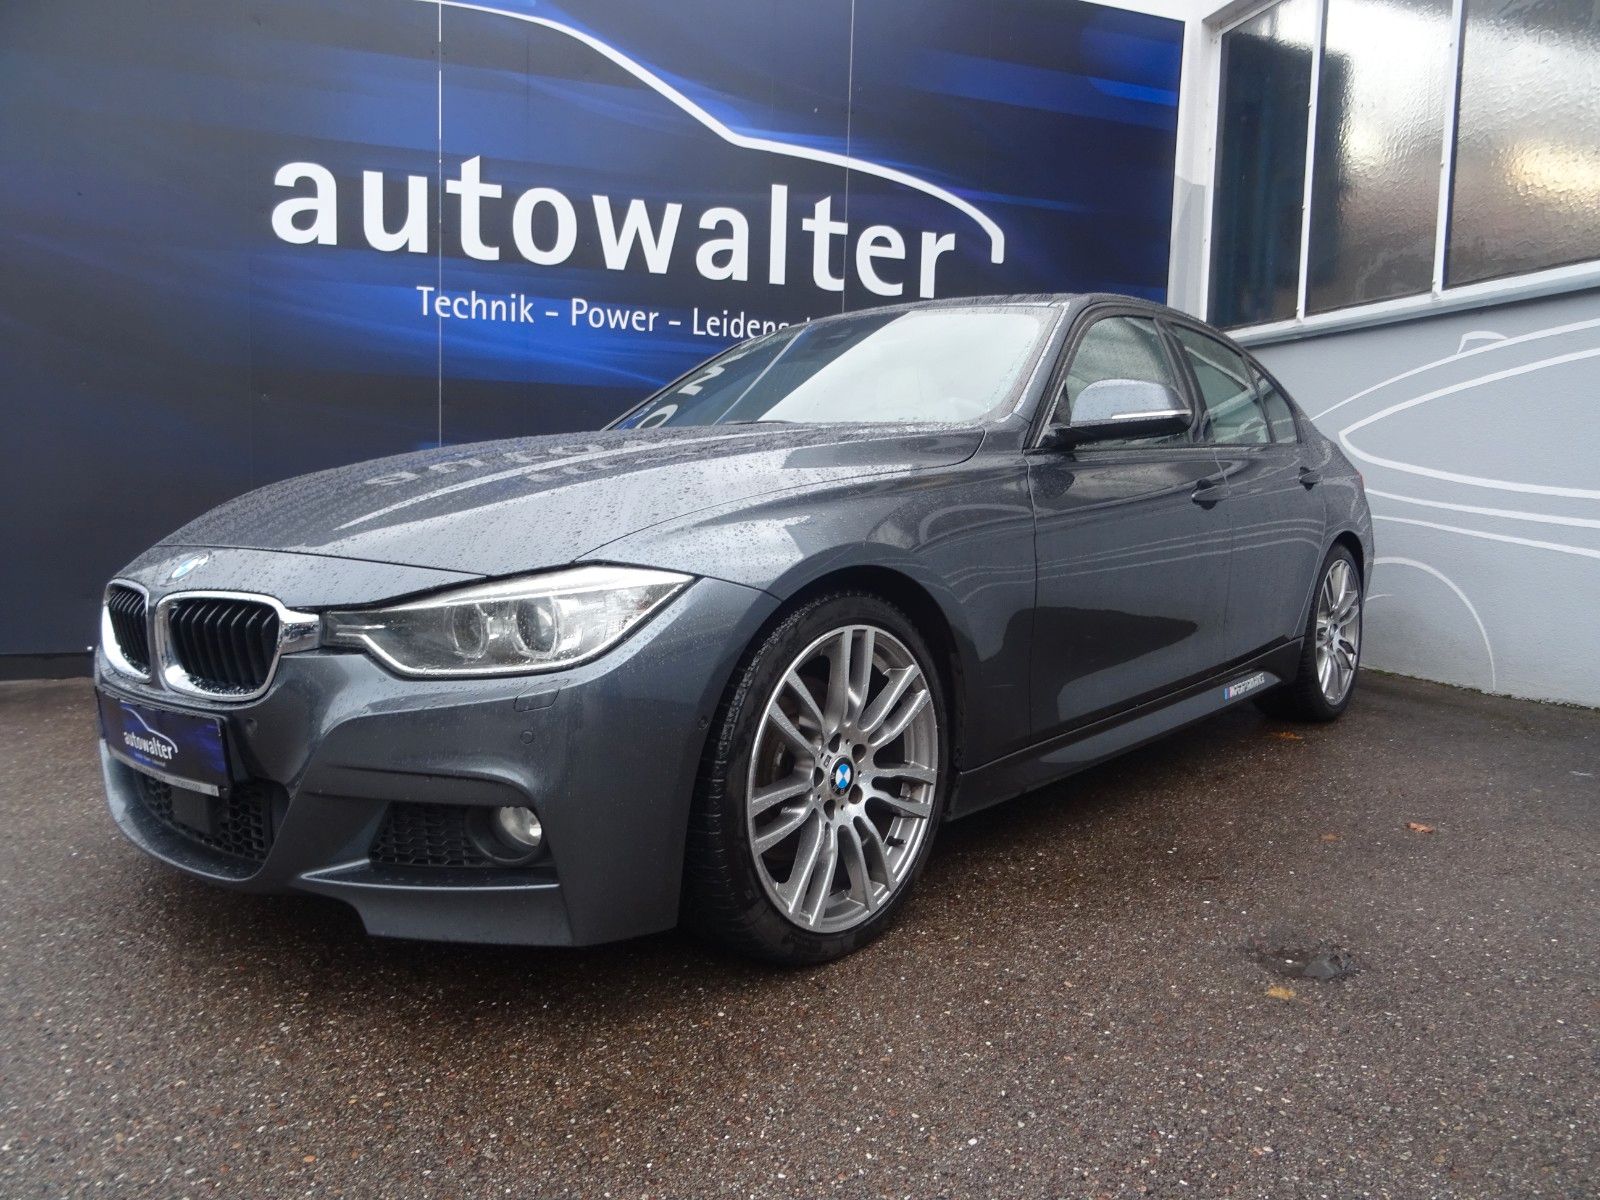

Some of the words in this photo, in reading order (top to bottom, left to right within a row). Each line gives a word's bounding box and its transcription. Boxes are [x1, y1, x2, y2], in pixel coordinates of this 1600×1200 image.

[270, 154, 956, 300] autowalter
[415, 285, 535, 324] Technik
[571, 297, 660, 332] Power
[123, 731, 173, 760] autowalter
